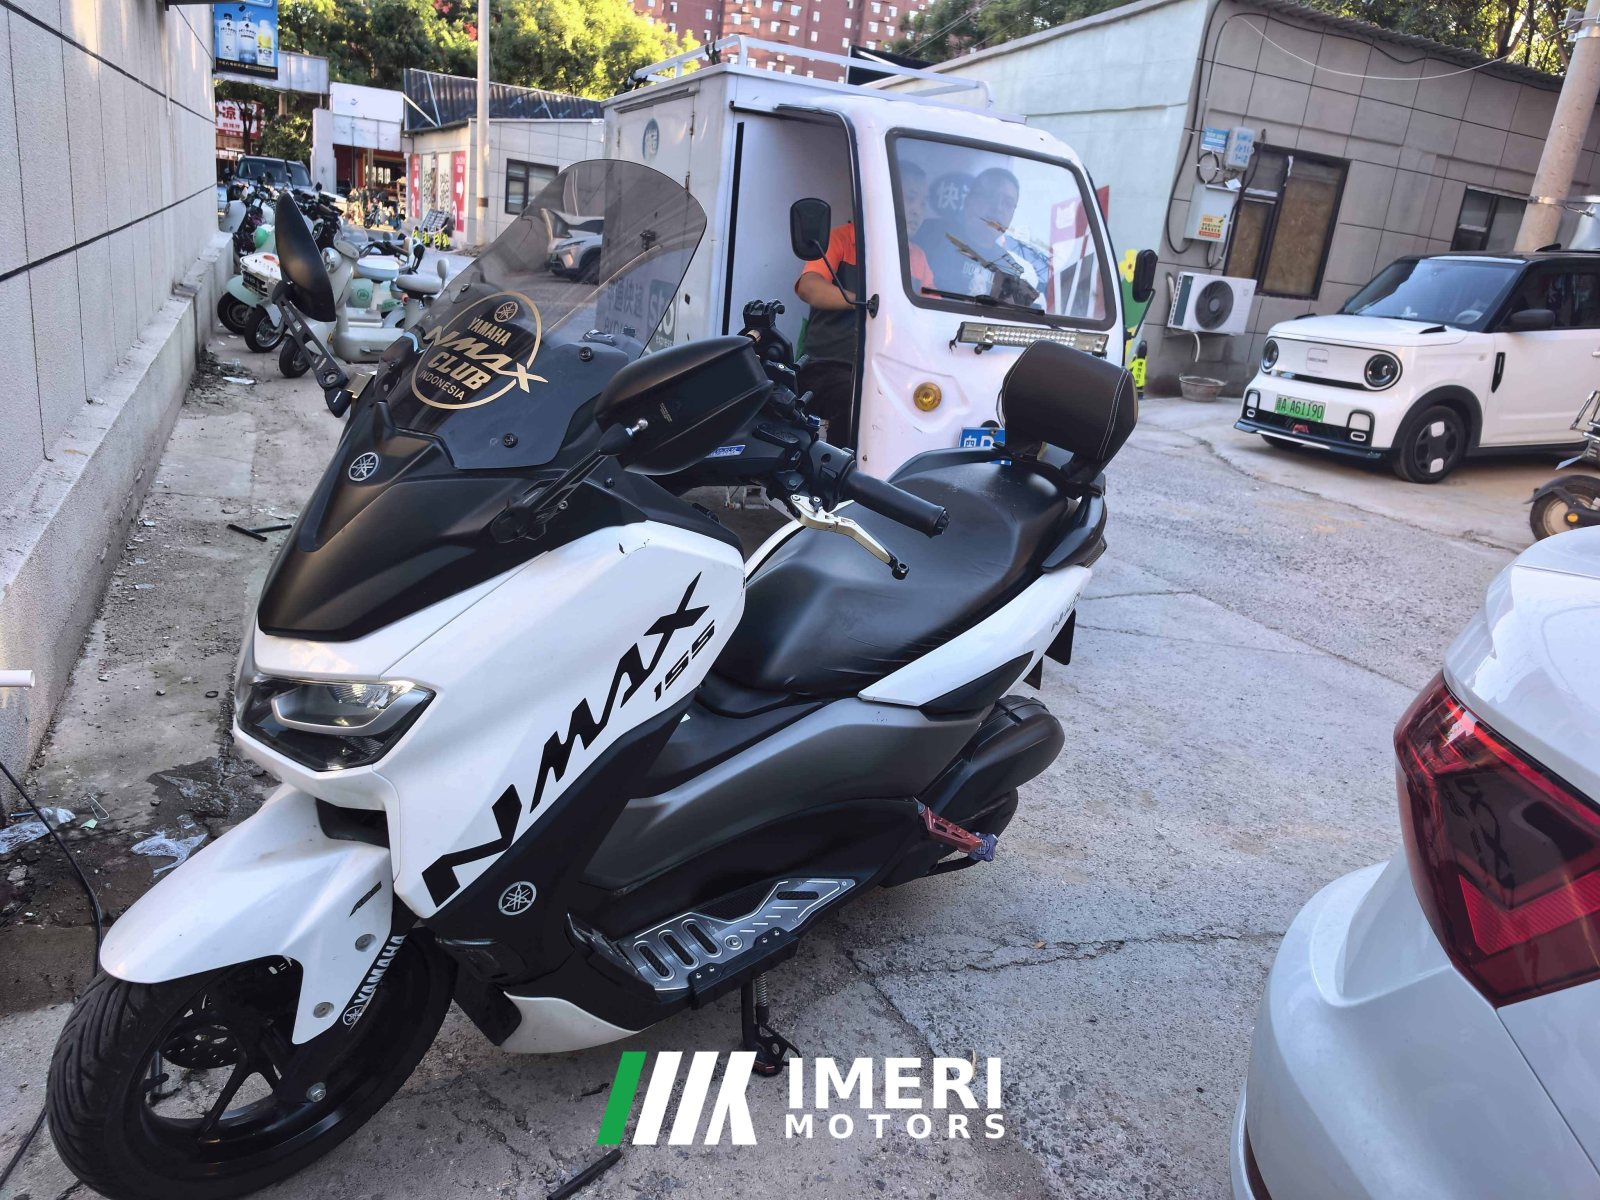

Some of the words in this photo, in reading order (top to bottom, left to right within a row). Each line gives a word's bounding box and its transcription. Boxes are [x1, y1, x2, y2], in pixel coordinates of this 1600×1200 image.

[467, 316, 512, 347] YAMAHA
[418, 369, 466, 401] INDONESIA
[423, 325, 549, 393] NMAX
[427, 351, 492, 390] CLUB
[1290, 400, 1324, 419] A61190
[654, 619, 715, 702] 155
[421, 571, 710, 908] NMAX
[353, 934, 408, 1004] YAMAHA
